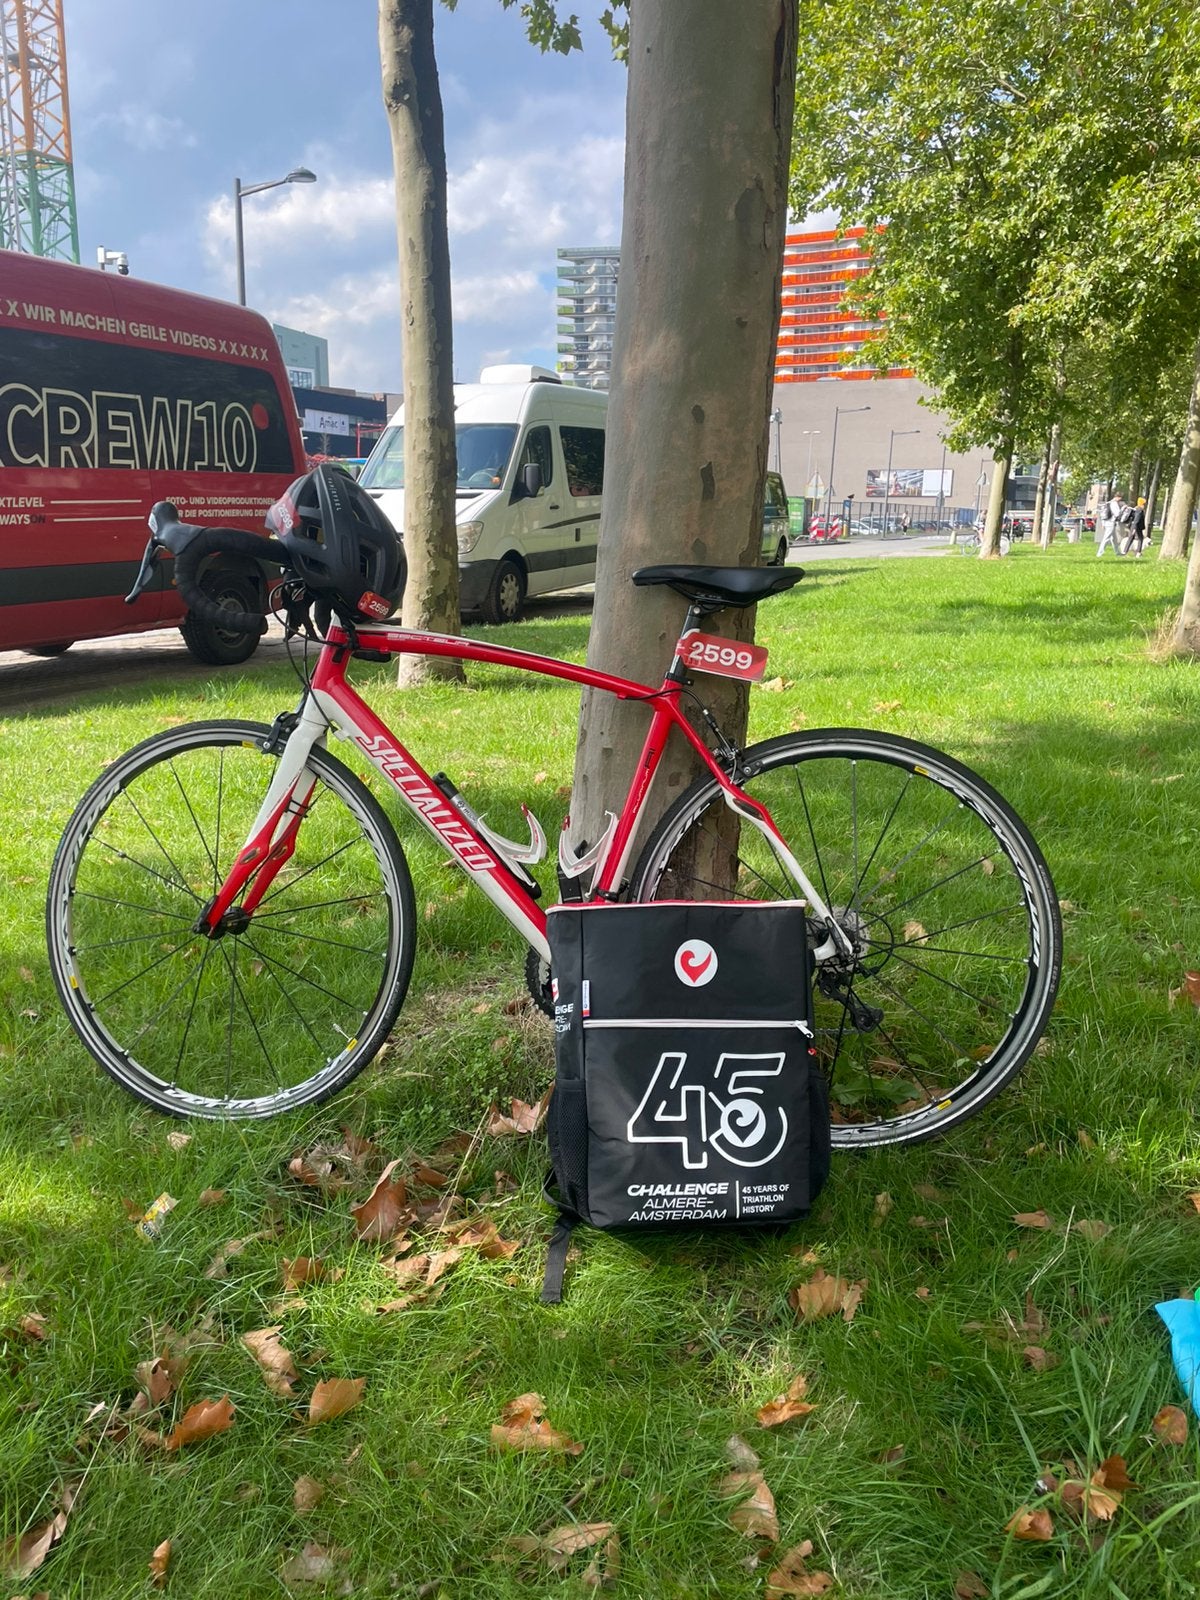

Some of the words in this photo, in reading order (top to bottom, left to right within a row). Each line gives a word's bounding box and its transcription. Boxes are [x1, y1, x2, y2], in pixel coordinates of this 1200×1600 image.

[6, 300, 20, 317] X
[22, 302, 56, 323] WIR
[60, 309, 126, 334] MACHEN
[128, 322, 168, 341] GEILE
[169, 329, 217, 351] VIDEOS
[0, 382, 257, 474] CREW10
[189, 496, 206, 505] UND
[184, 509, 197, 518] DIE
[198, 508, 253, 518] POSITIONIERUNG
[368, 600, 389, 616] 2599
[688, 641, 752, 669] 2599
[354, 734, 498, 872] SPECIALIZED
[627, 1051, 787, 1170] 45
[627, 1182, 729, 1197] CHALLENGE
[742, 1185, 752, 1194] 45
[752, 1184, 778, 1193] YEARS
[779, 1183, 790, 1192] OF
[642, 1197, 714, 1209] ALMERE-
[742, 1194, 784, 1203] TRIATHLON
[628, 1208, 727, 1222] AMSTERDAM
[742, 1204, 775, 1214] HISTORY
